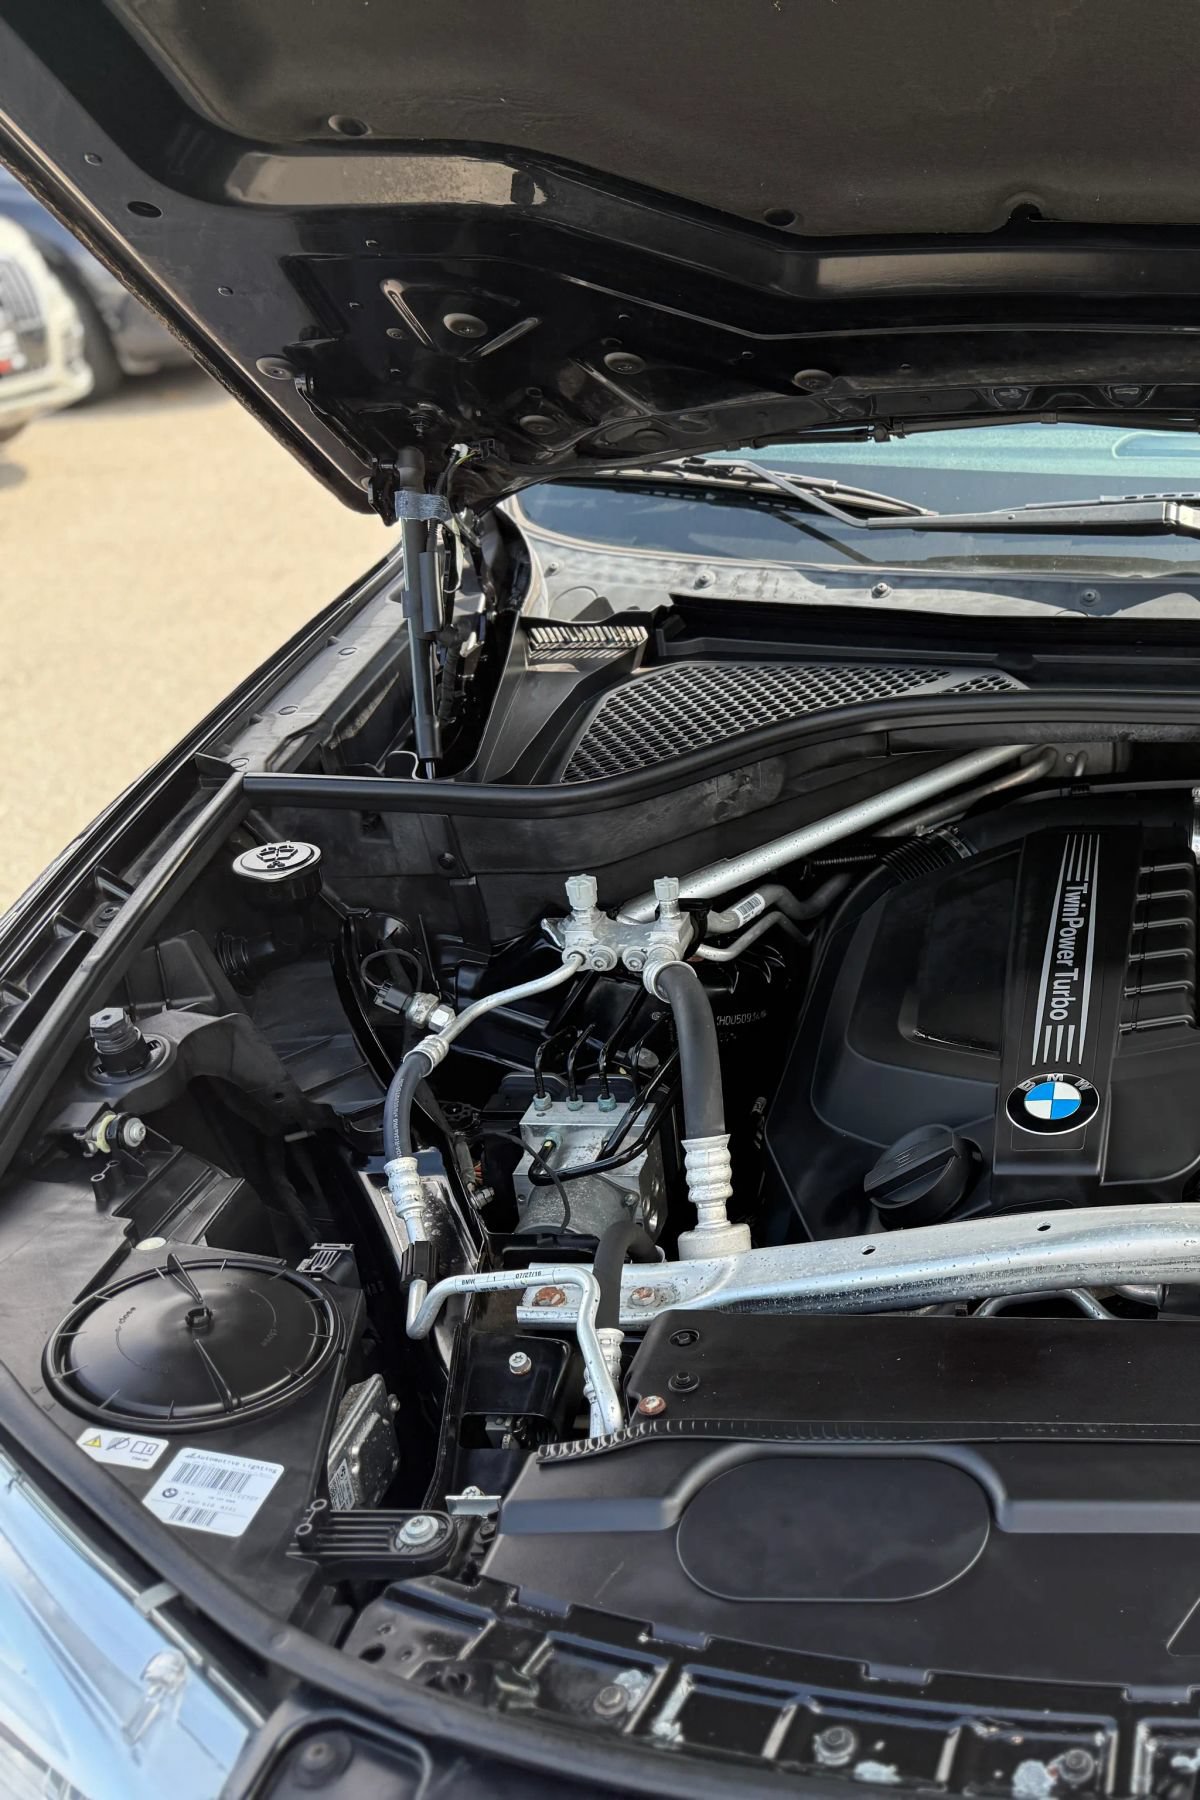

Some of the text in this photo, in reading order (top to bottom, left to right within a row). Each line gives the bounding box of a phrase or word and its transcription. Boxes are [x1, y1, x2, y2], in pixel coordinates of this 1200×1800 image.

[1049, 882, 1089, 1021] TwinPower Turbo
[1017, 1073, 1093, 1092] BMW
[461, 1278, 476, 1286] BMW
[197, 1454, 278, 1474] Automotive Lighting
